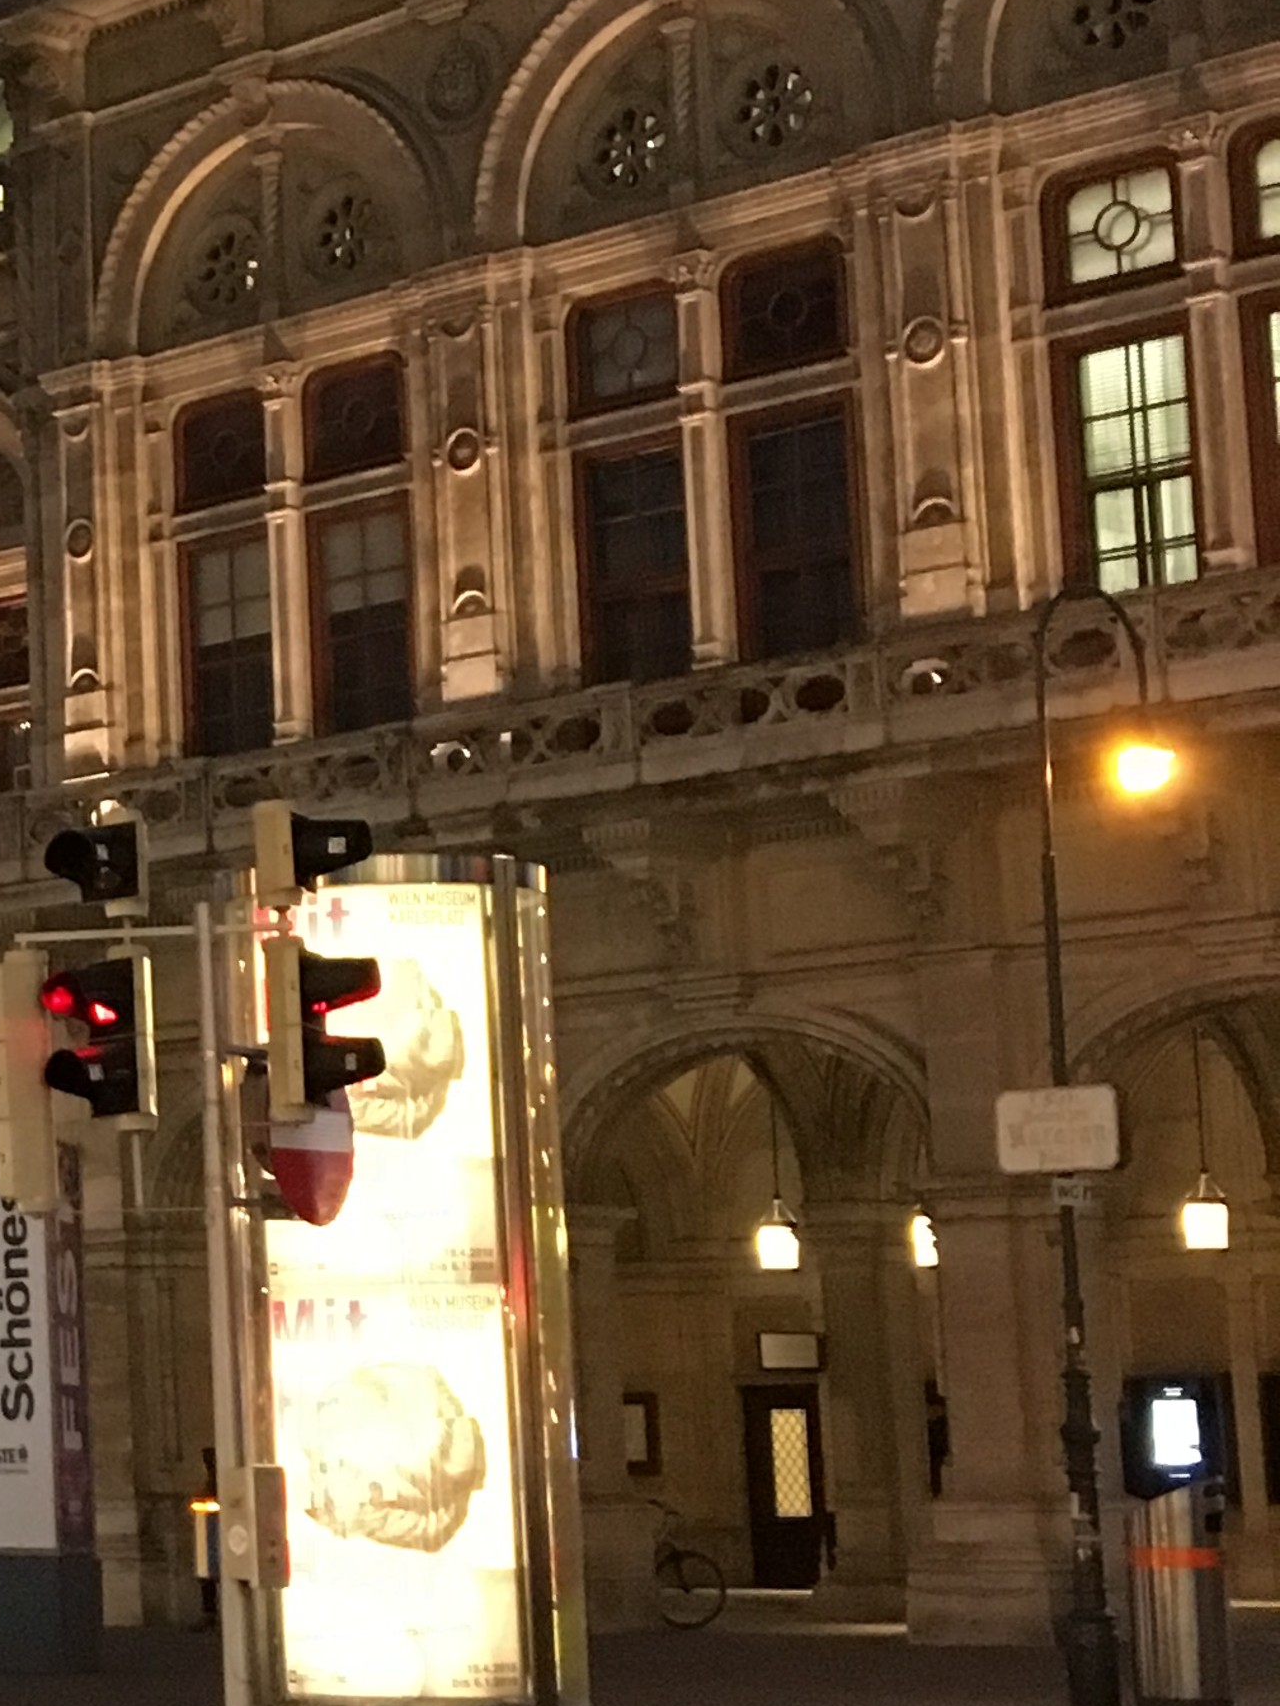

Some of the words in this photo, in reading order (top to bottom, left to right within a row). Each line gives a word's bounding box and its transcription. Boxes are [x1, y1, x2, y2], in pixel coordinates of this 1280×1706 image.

[389, 891, 420, 905] WIEN
[426, 890, 476, 905] MUSEUM
[272, 1298, 366, 1340] Mit
[446, 1295, 495, 1309] MUSEUM
